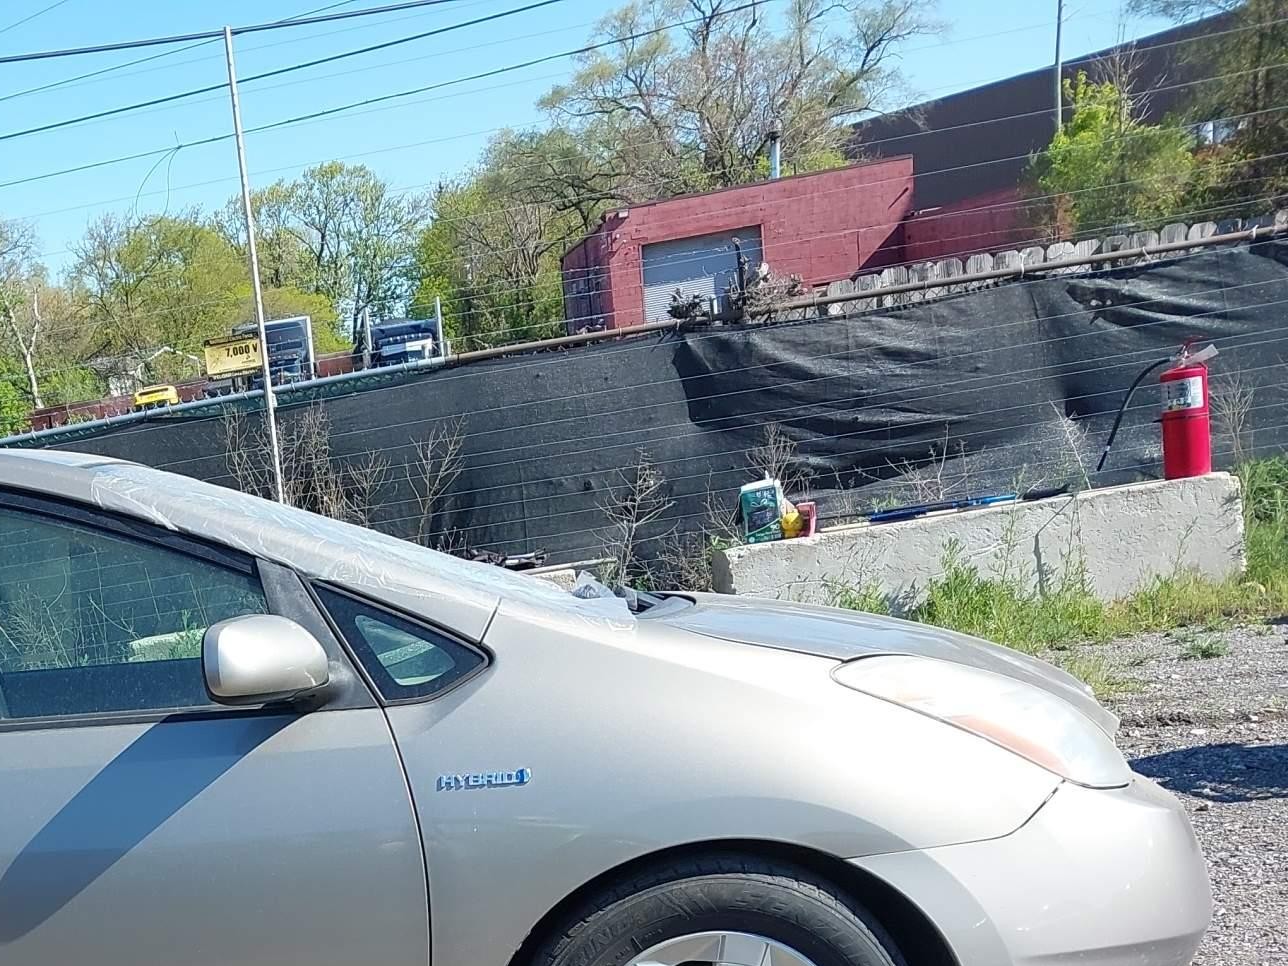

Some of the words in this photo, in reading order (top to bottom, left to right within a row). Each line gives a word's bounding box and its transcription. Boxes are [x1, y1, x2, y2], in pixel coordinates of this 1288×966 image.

[226, 345, 250, 357] 7,000
[252, 343, 258, 352] V
[437, 770, 518, 791] HYBRID
